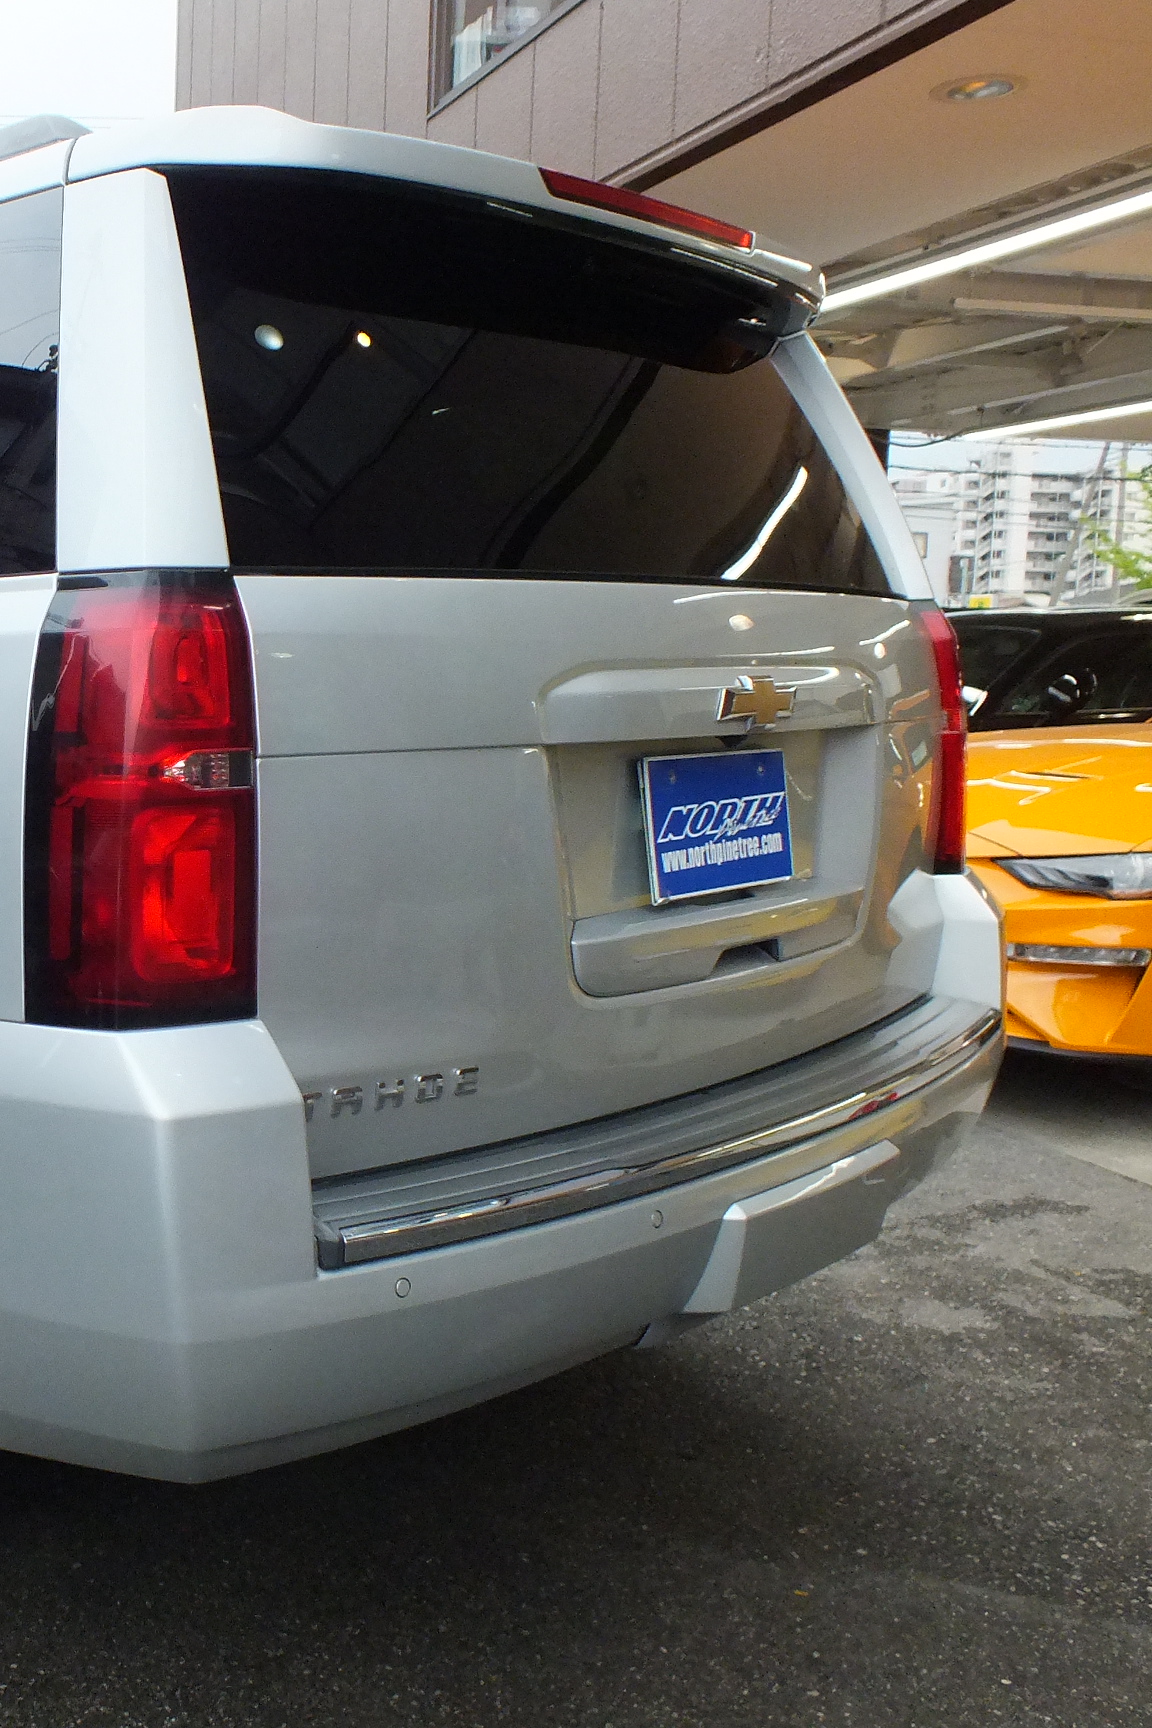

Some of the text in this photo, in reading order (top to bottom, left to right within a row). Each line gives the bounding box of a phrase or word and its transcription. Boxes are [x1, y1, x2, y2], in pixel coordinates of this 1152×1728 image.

[657, 791, 785, 843] NORTH
[661, 832, 783, 873] www.northpinetree.com
[302, 1066, 480, 1122] TAHOE
